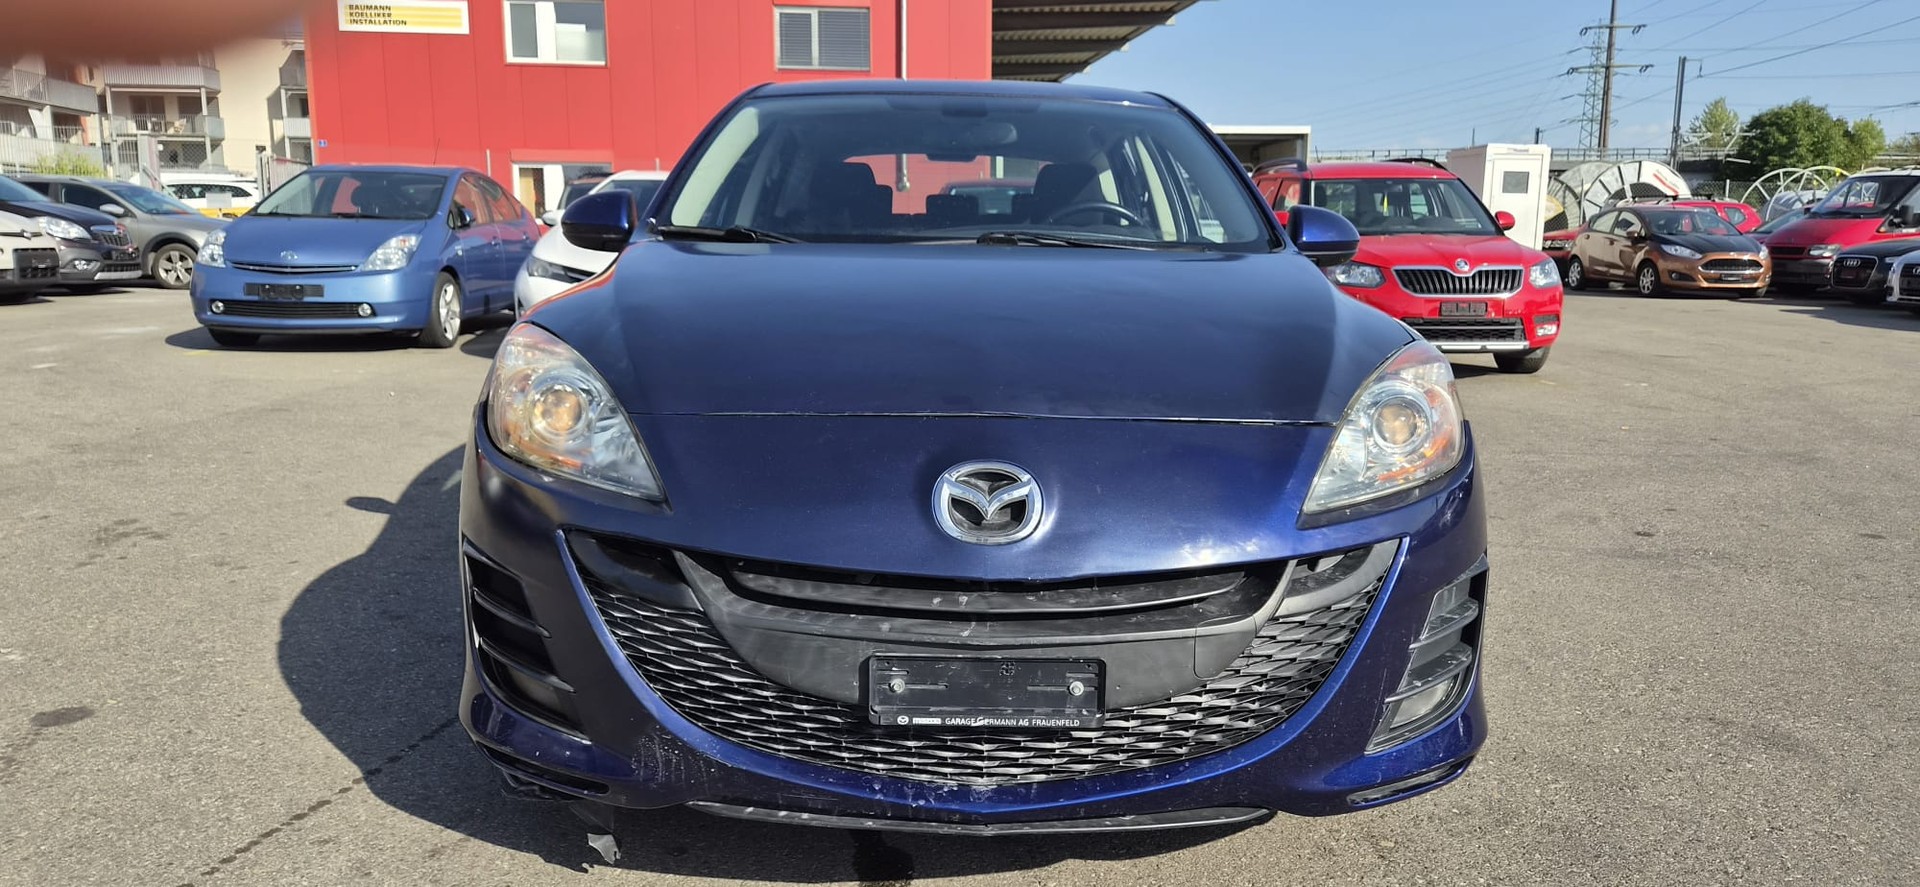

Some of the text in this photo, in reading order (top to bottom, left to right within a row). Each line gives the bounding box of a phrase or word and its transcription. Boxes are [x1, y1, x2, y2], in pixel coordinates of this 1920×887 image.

[350, 18, 407, 26] INSTALLATION
[945, 717, 974, 725] GARAGE
[974, 716, 1017, 726] GERMANN
[1018, 718, 1029, 726] AG
[1032, 718, 1080, 727] FRAUENFELD
